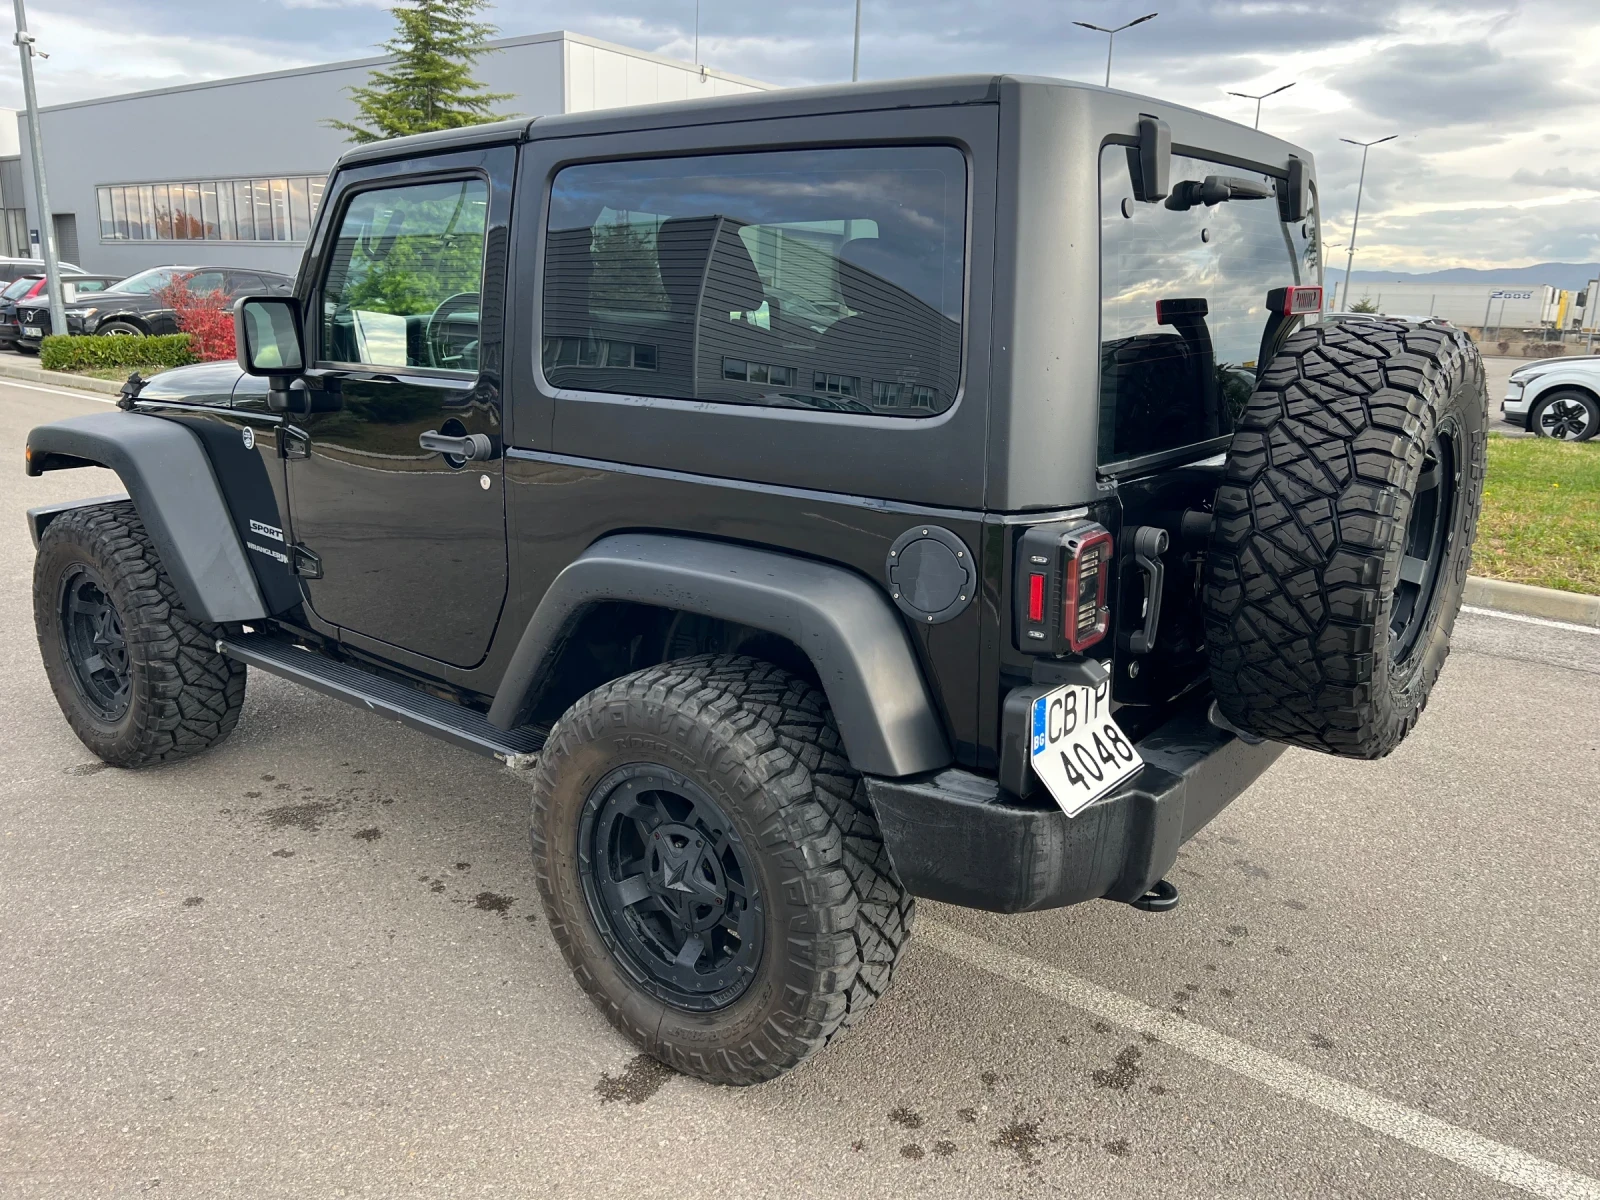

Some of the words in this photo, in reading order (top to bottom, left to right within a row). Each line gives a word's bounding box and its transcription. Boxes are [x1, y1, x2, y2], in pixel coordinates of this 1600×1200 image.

[1491, 290, 1531, 299] 2000
[250, 522, 283, 538] SPORT
[246, 541, 280, 559] WRANGLER
[1034, 733, 1045, 750] BG
[1060, 724, 1133, 790] 4048
